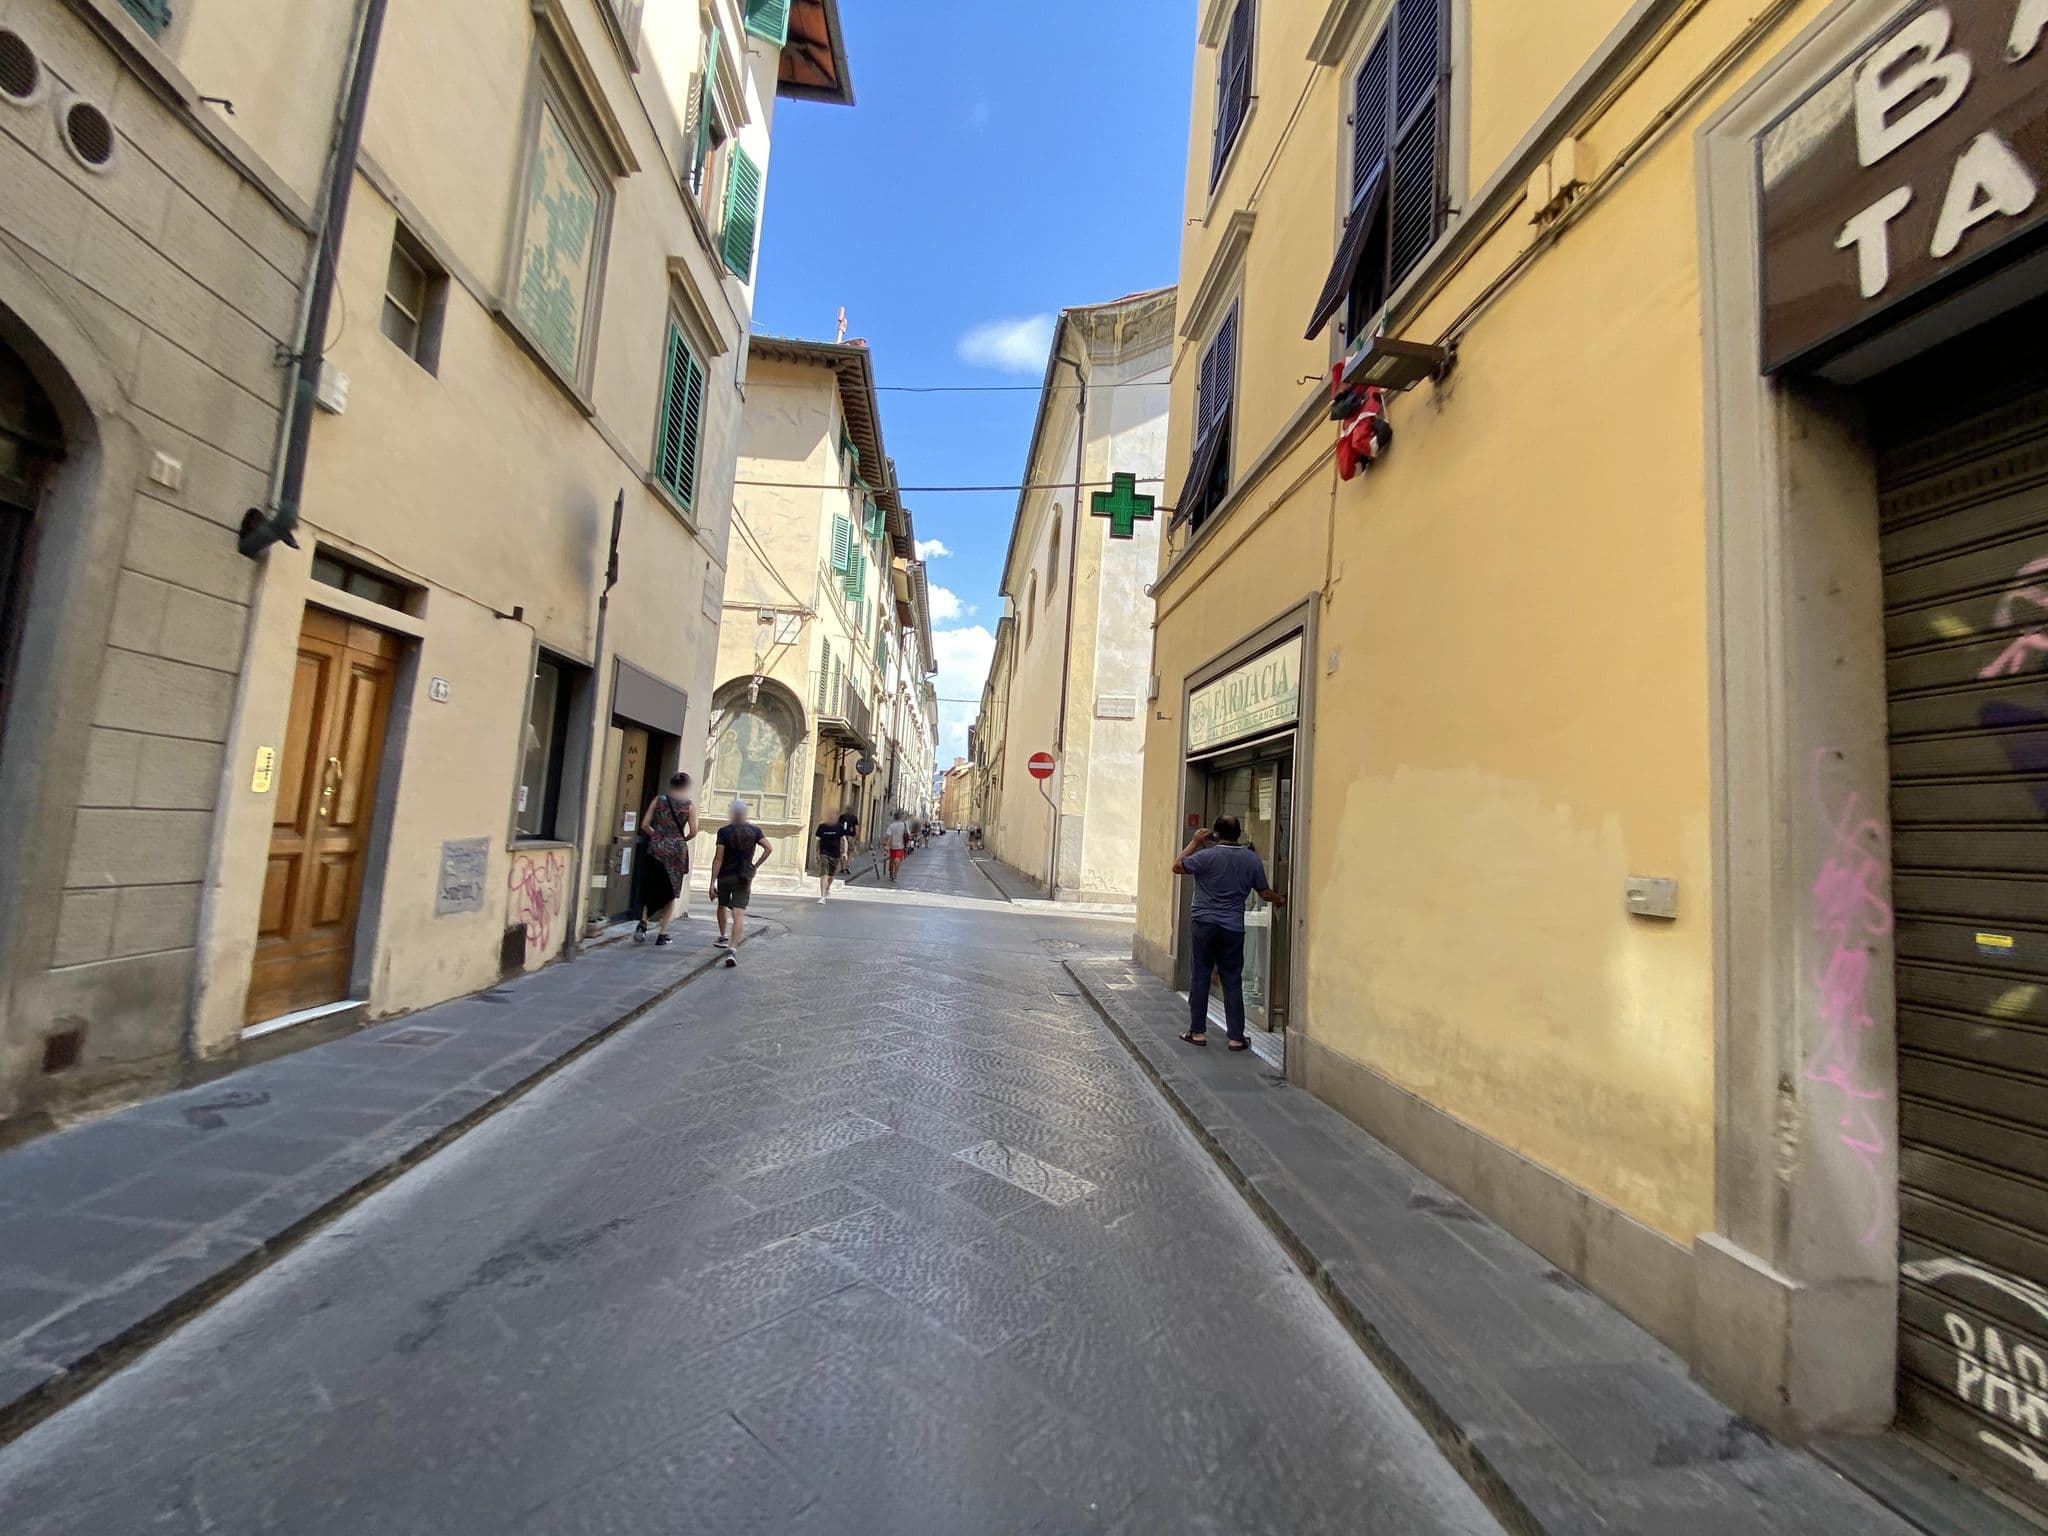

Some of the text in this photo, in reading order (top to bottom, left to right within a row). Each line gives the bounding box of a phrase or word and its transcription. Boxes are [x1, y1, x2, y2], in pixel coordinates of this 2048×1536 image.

[1854, 8, 2048, 168] B
[1834, 131, 2037, 298] TA
[1213, 656, 1289, 720] FARMACIA
